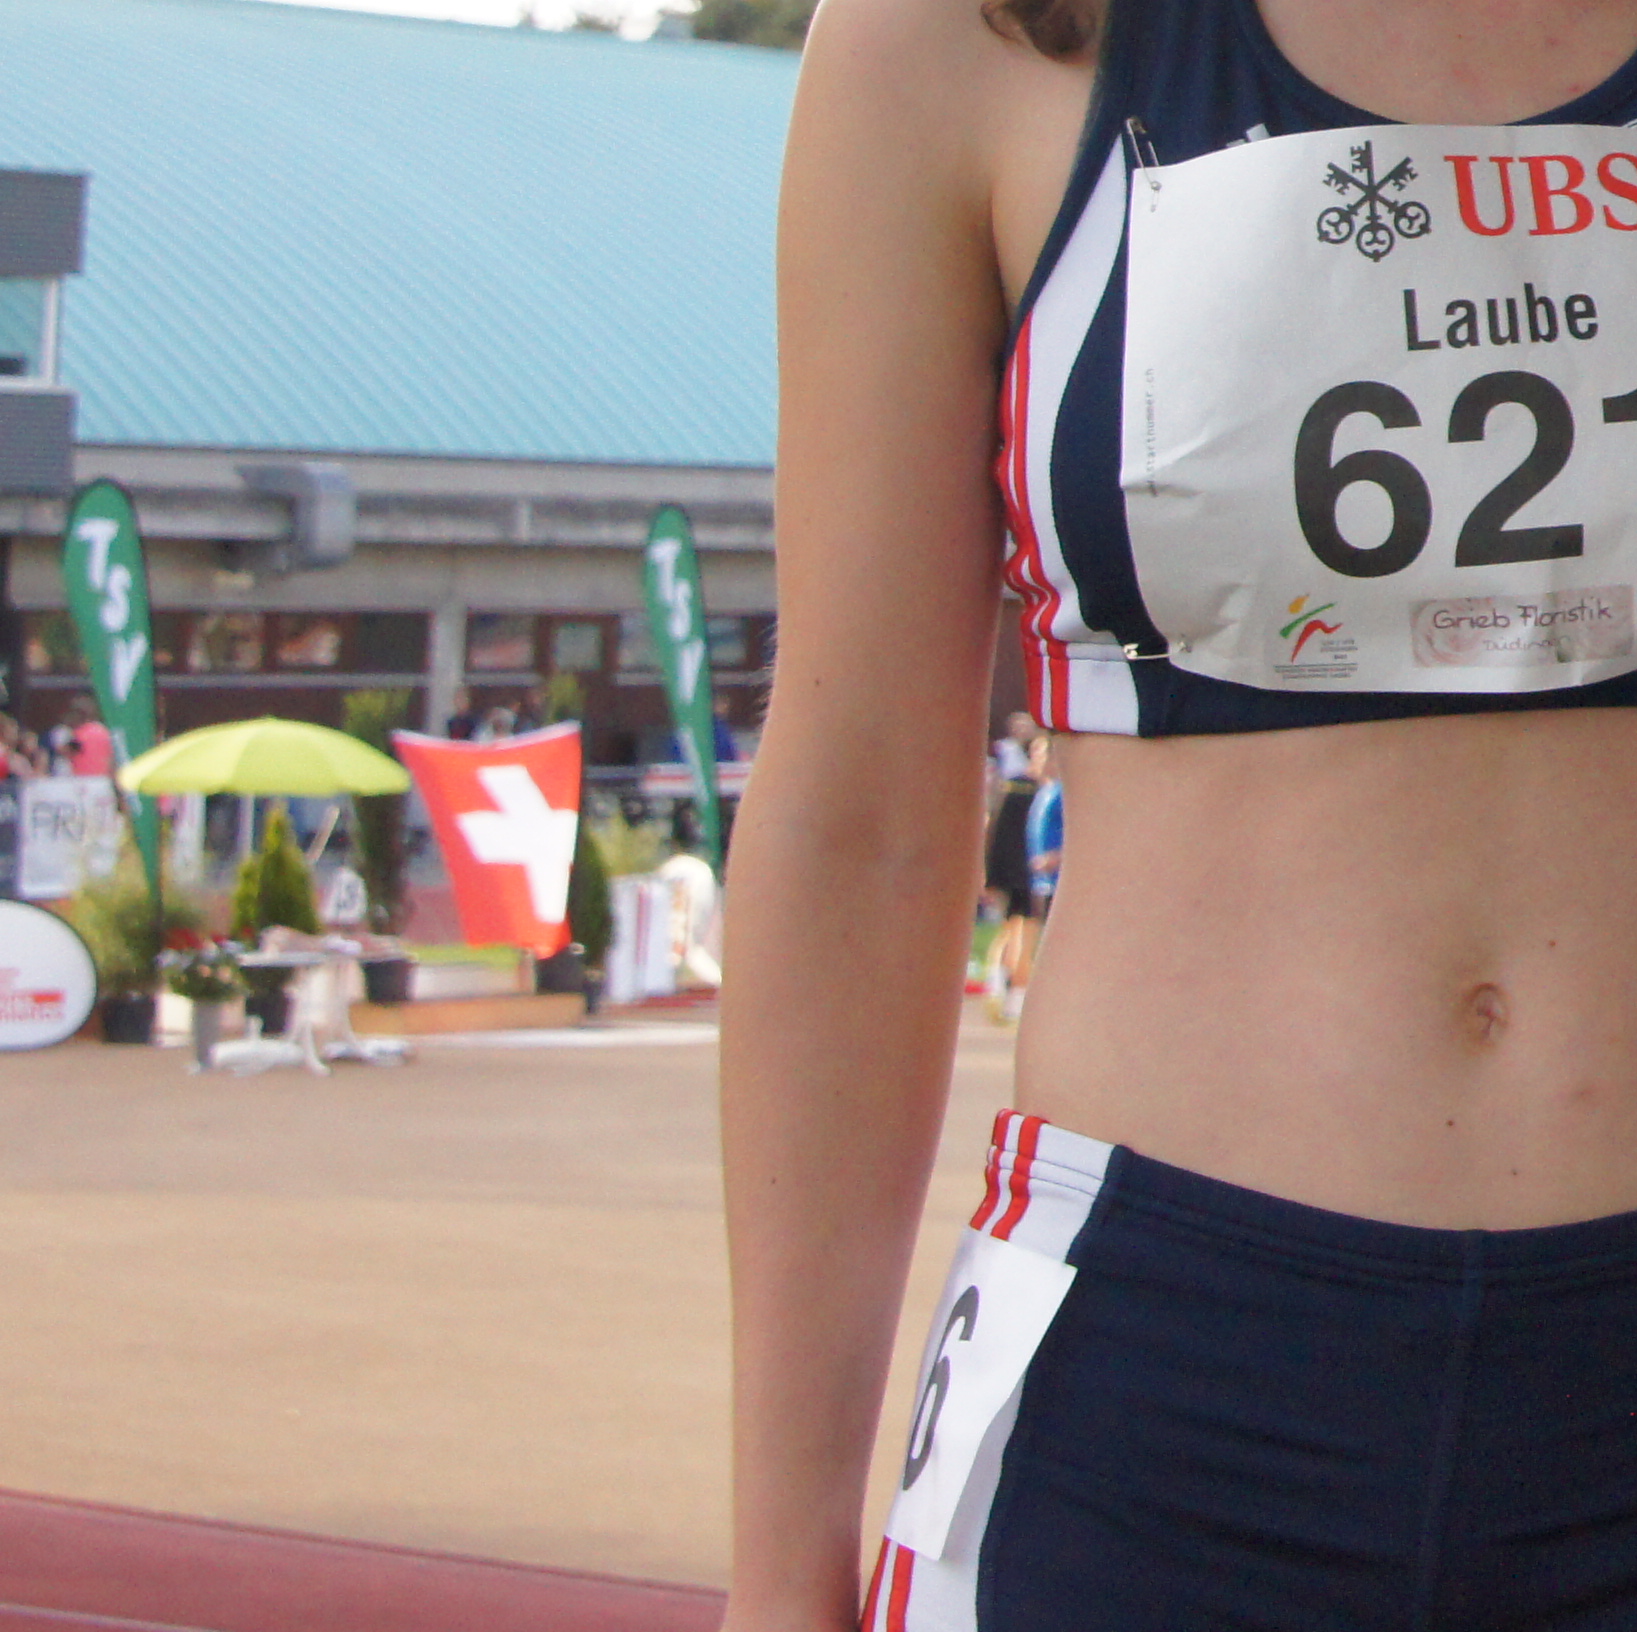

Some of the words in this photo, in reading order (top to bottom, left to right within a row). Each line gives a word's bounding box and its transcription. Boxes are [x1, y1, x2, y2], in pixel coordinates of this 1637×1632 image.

[1403, 282, 1599, 352] Laube
[72, 517, 148, 703] TSV
[649, 538, 704, 705] TSV
[1433, 606, 1511, 630] Grieb
[1517, 600, 1612, 628] Floristik
[903, 1285, 980, 1491] 6
